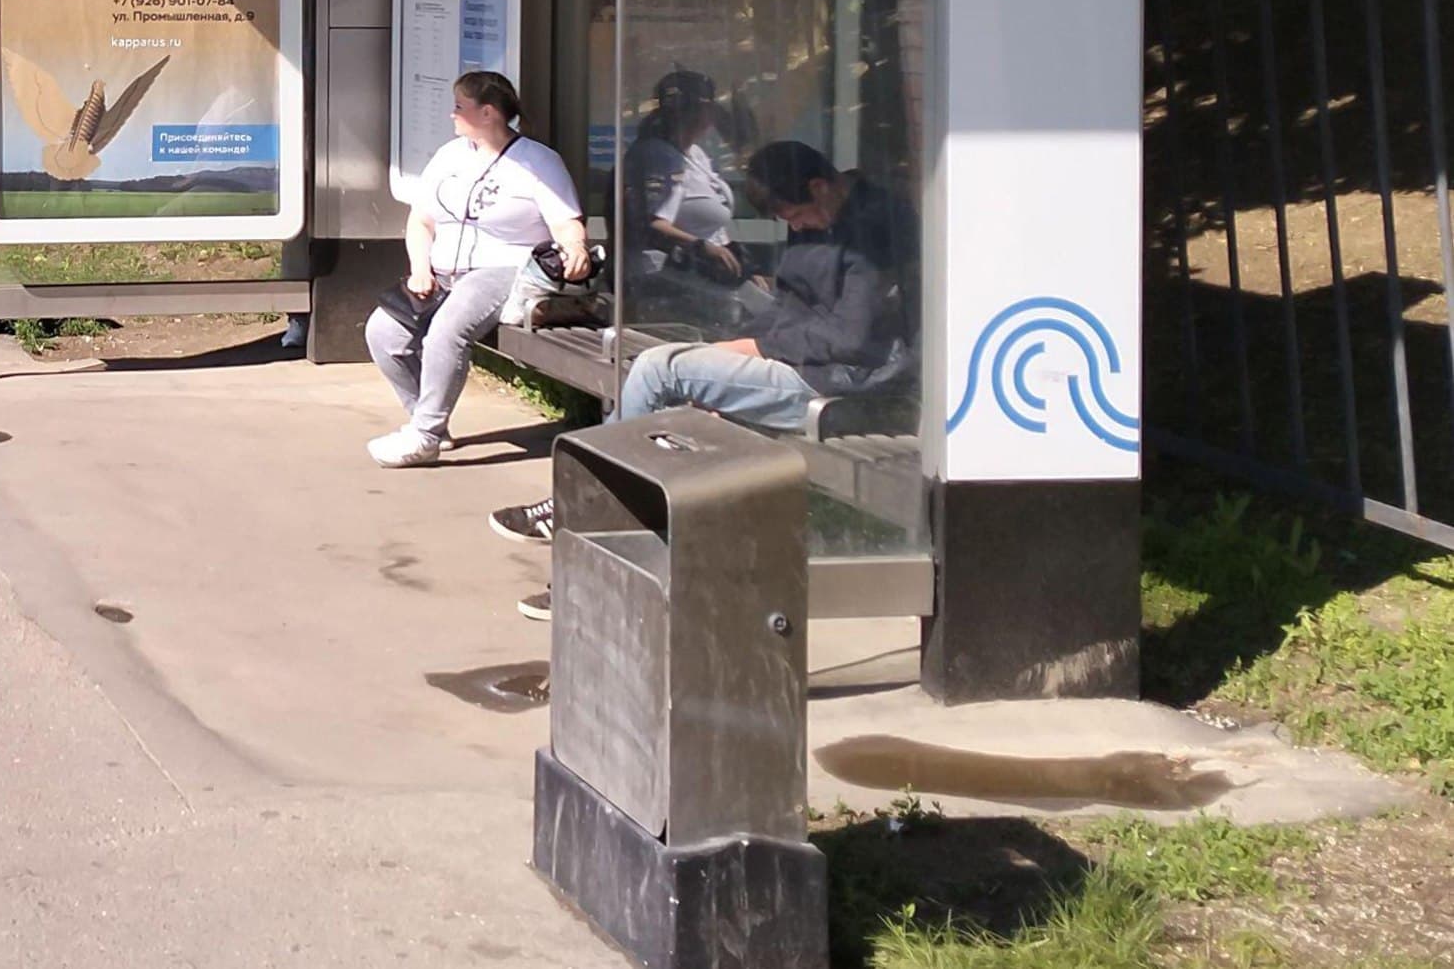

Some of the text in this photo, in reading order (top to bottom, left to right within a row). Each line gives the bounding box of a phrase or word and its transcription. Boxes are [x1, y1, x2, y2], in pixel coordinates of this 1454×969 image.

[112, 11, 130, 24] ул.
[132, 11, 232, 23] Промышленная,
[111, 36, 182, 49] kapparus.ru
[159, 132, 252, 143] Присоединяйтесь
[168, 145, 200, 154] нашей
